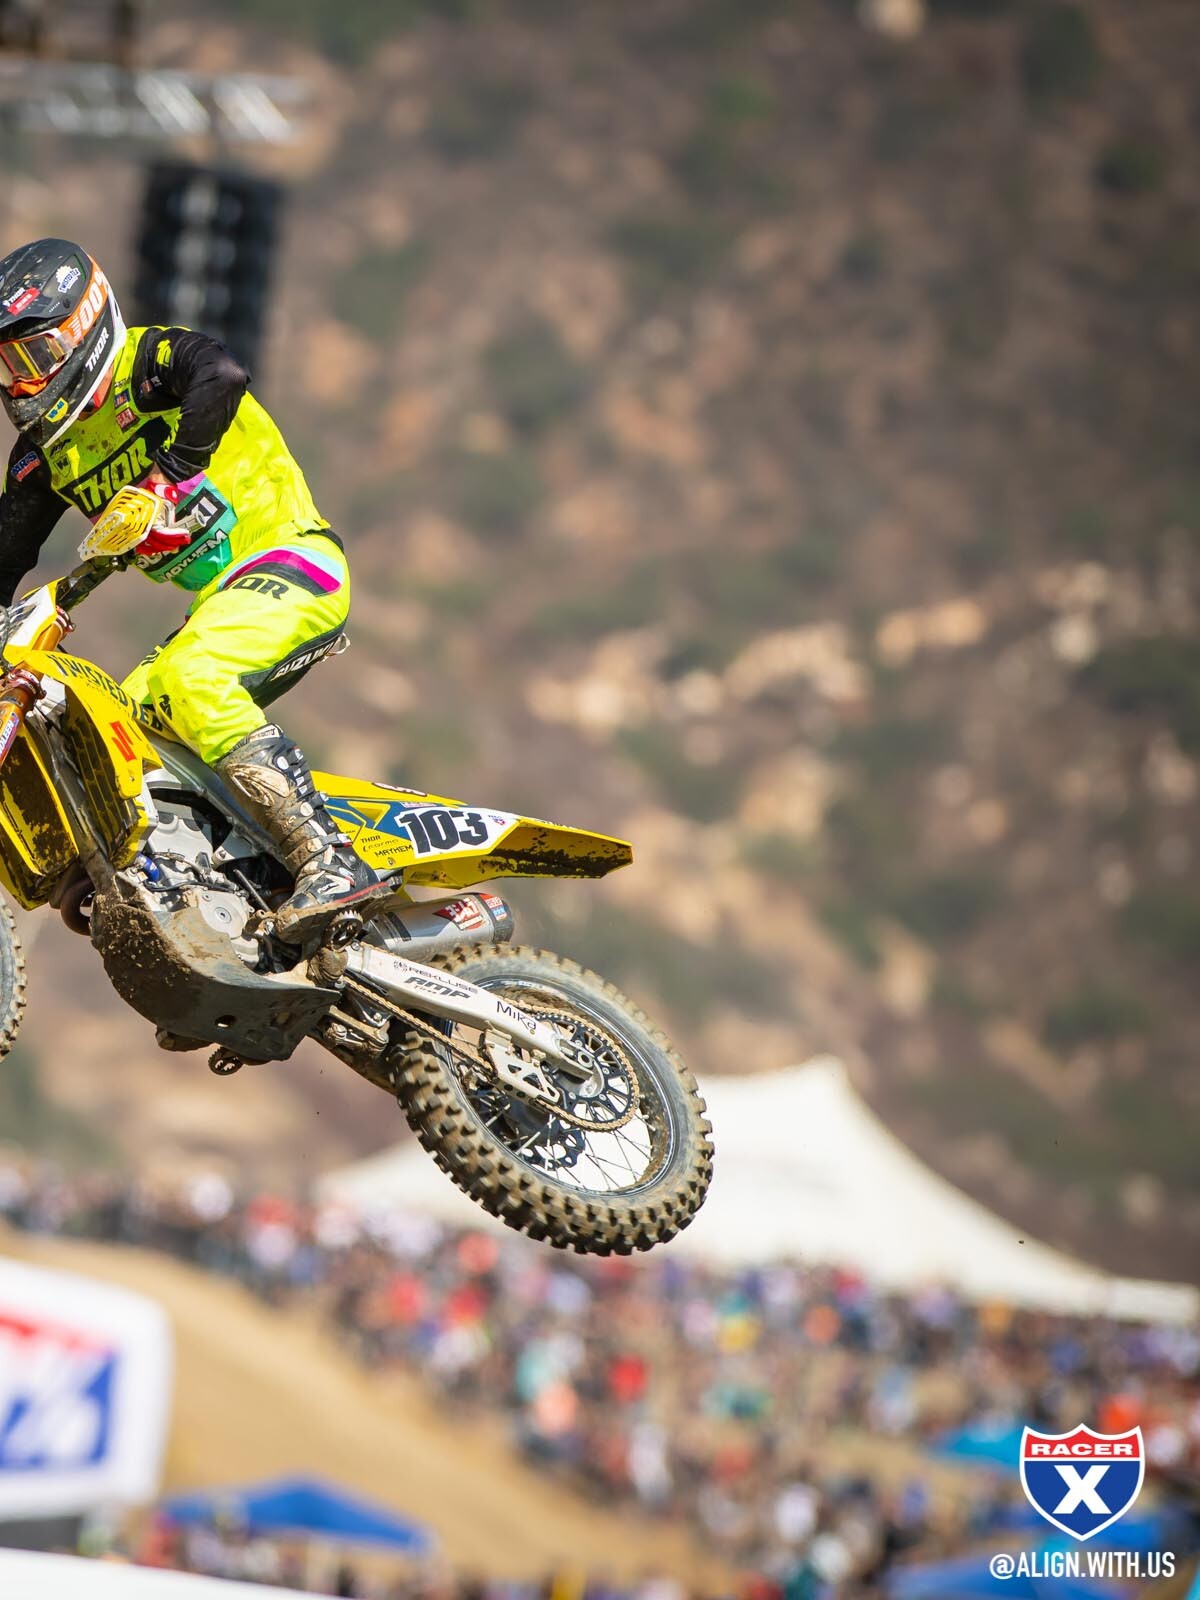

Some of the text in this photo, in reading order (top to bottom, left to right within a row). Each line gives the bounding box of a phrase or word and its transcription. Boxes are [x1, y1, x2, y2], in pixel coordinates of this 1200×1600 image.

[85, 327, 109, 371] THOR
[73, 437, 153, 512] THOR
[46, 654, 128, 707] TWISTED
[360, 834, 381, 844] THOR
[399, 810, 489, 854] 103
[374, 845, 414, 858] MAYHEM
[404, 976, 471, 999] AMP
[408, 967, 478, 994] REKLUSE
